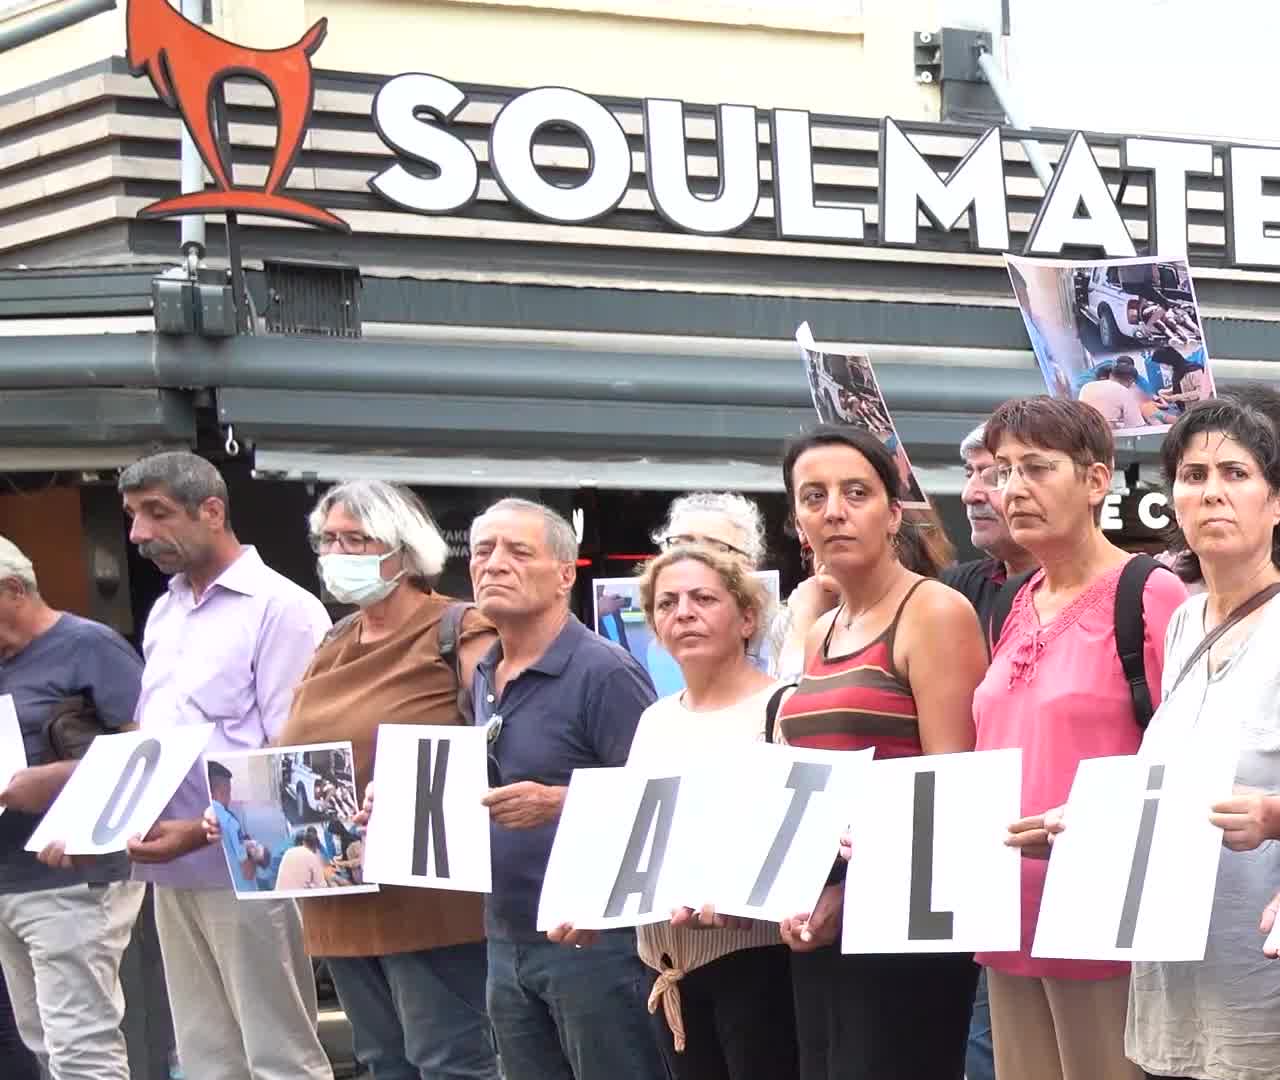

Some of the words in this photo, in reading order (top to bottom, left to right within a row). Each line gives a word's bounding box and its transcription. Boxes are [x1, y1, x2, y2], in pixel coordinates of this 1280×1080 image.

[92, 739, 161, 845] O
[412, 738, 450, 878] K
[602, 776, 681, 917] A
[746, 761, 833, 907] T
[907, 771, 954, 940] L
